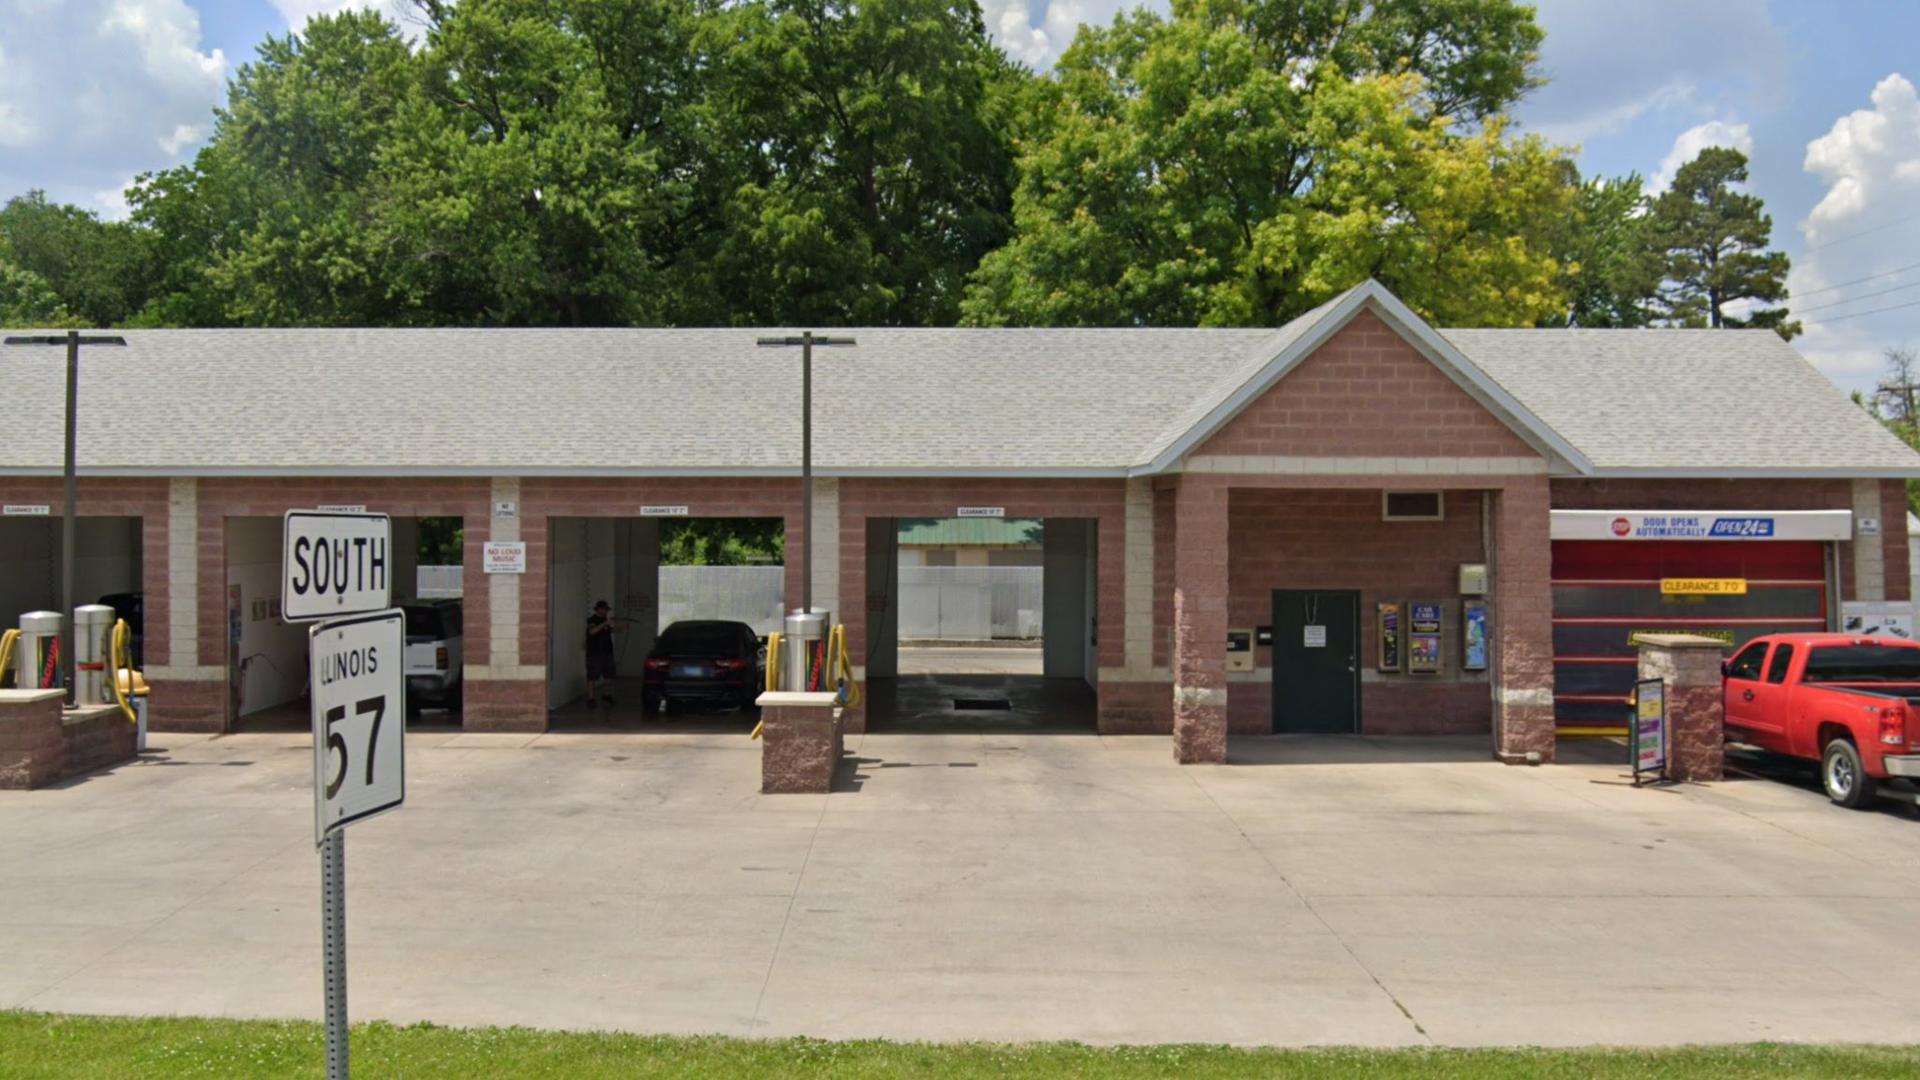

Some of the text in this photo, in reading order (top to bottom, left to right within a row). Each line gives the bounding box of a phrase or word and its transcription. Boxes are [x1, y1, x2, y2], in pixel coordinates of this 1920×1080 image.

[1643, 518, 1699, 527] DOOR OPENS
[1740, 520, 1759, 535] 24
[1636, 527, 1706, 537] AUTOMATICALLY
[292, 535, 385, 595] SOUTH
[1664, 581, 1720, 592] CLEARANCE
[321, 646, 378, 686] LLINOIS
[325, 694, 386, 800] 57
